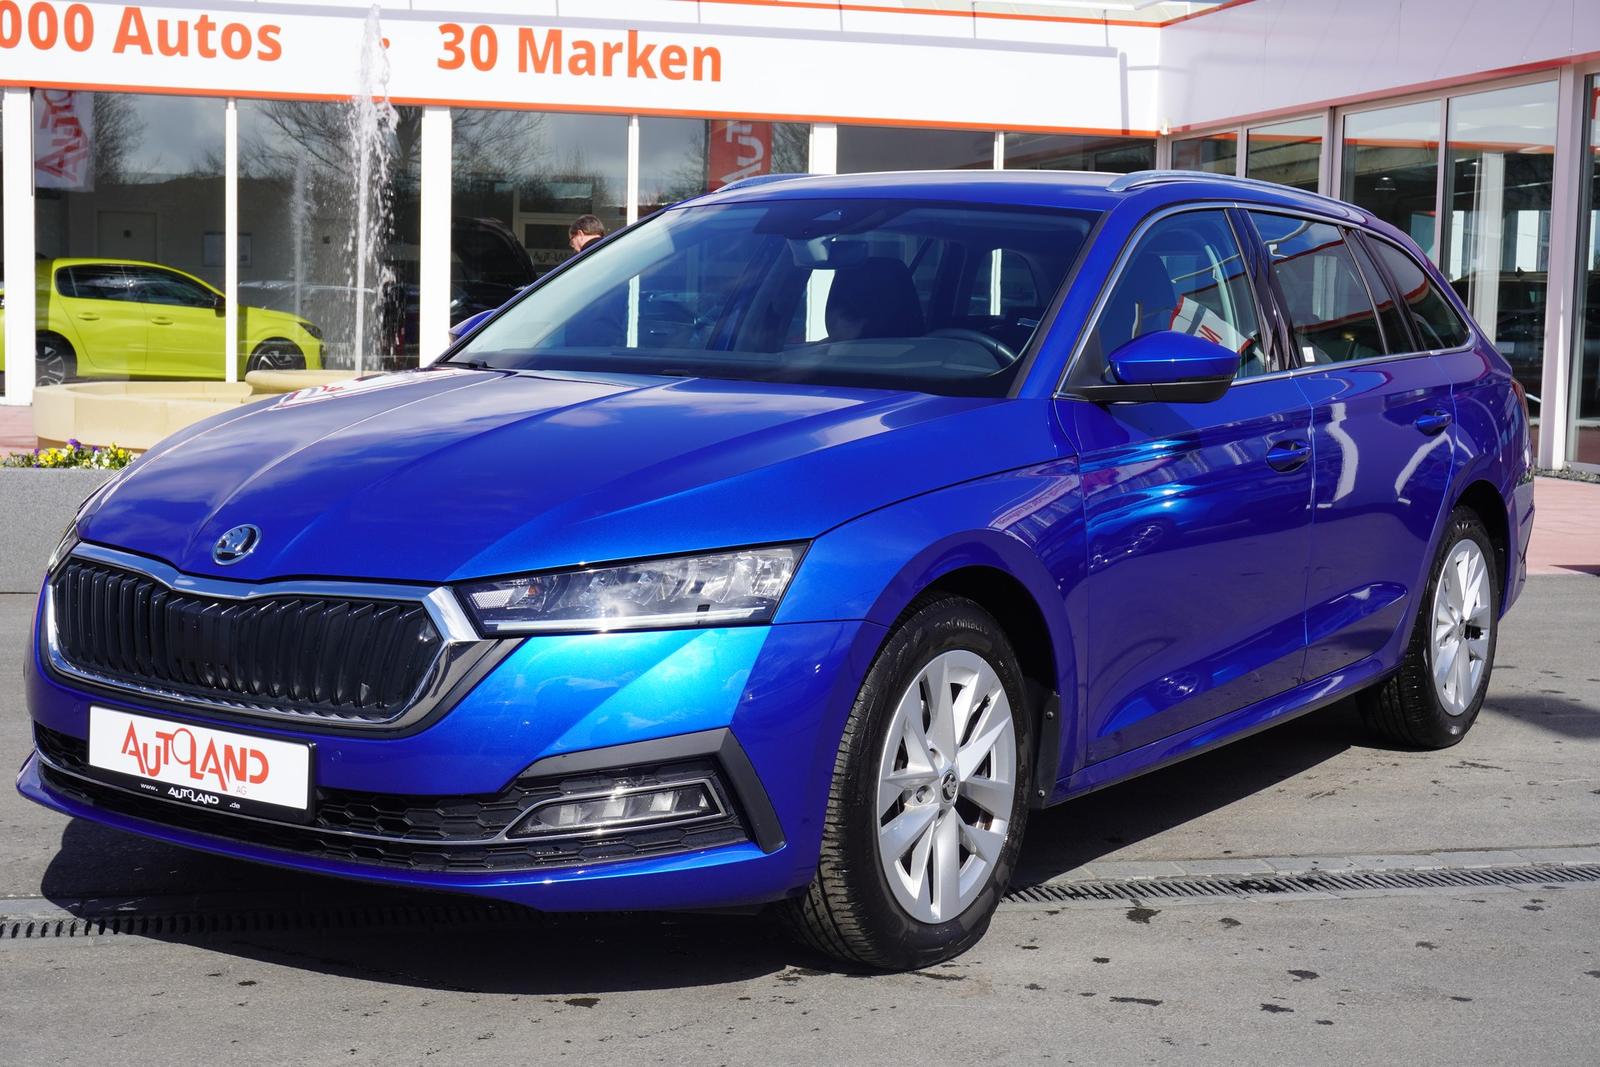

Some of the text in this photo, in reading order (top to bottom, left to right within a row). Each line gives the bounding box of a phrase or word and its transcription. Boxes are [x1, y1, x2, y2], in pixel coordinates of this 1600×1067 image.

[0, 0, 722, 82] 000 Autos 30 Marken
[121, 720, 269, 791] AUTOLAND
[167, 786, 219, 804] AUTOLAND
[236, 785, 247, 796] AG
